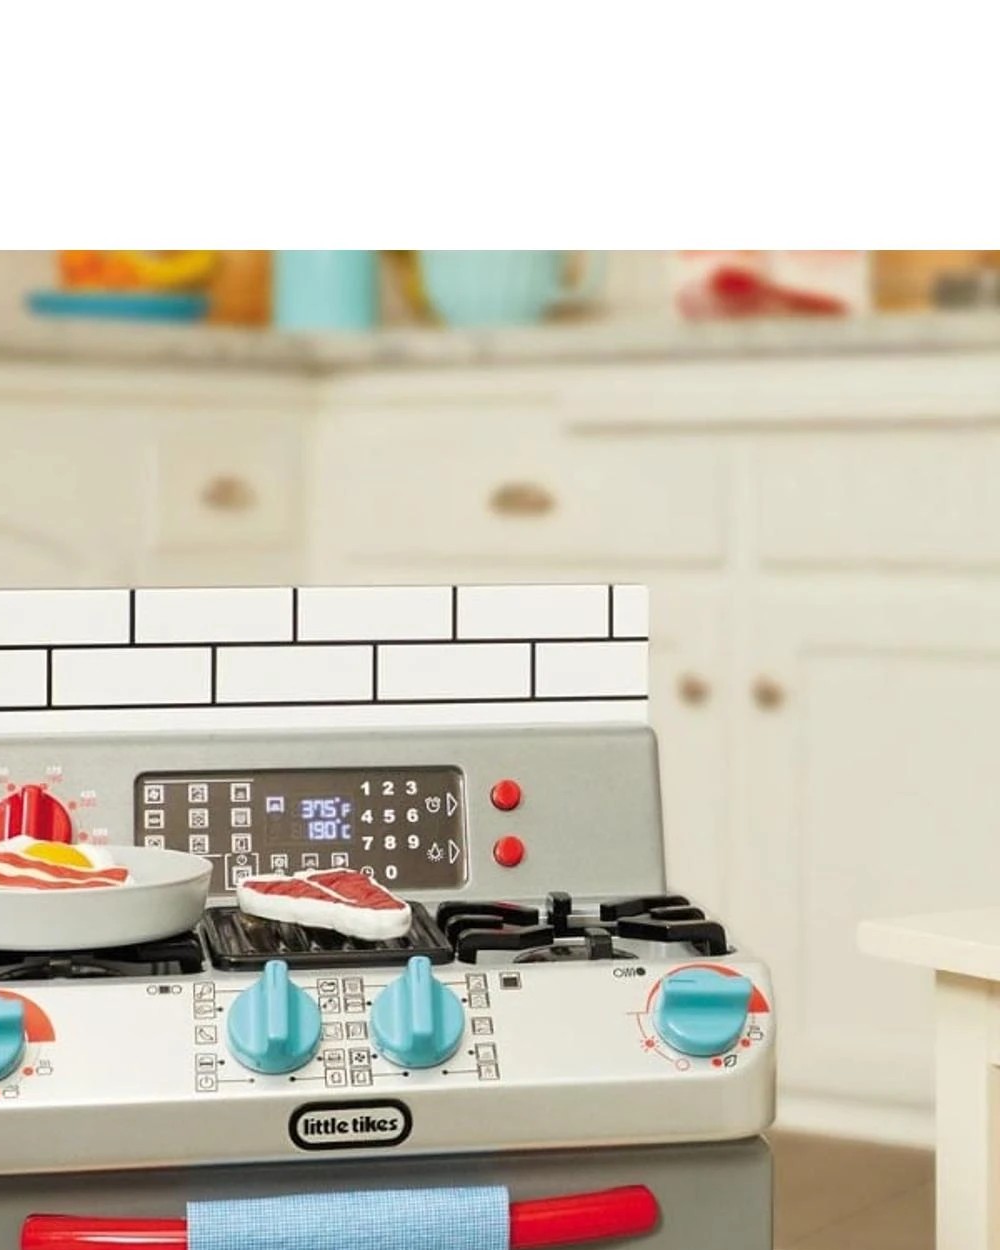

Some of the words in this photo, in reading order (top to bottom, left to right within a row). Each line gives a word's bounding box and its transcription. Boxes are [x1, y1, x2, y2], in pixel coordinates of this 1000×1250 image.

[360, 781, 370, 796] 1
[382, 781, 395, 795] 2
[405, 781, 418, 795] 3
[361, 809, 373, 824] 4
[383, 809, 396, 823] 5
[406, 808, 419, 823] 6
[362, 836, 374, 850] 7
[384, 835, 397, 850] 8
[407, 835, 420, 849] 9
[385, 865, 398, 879] 0
[303, 1118, 349, 1136] little
[352, 1116, 398, 1133] tikes
